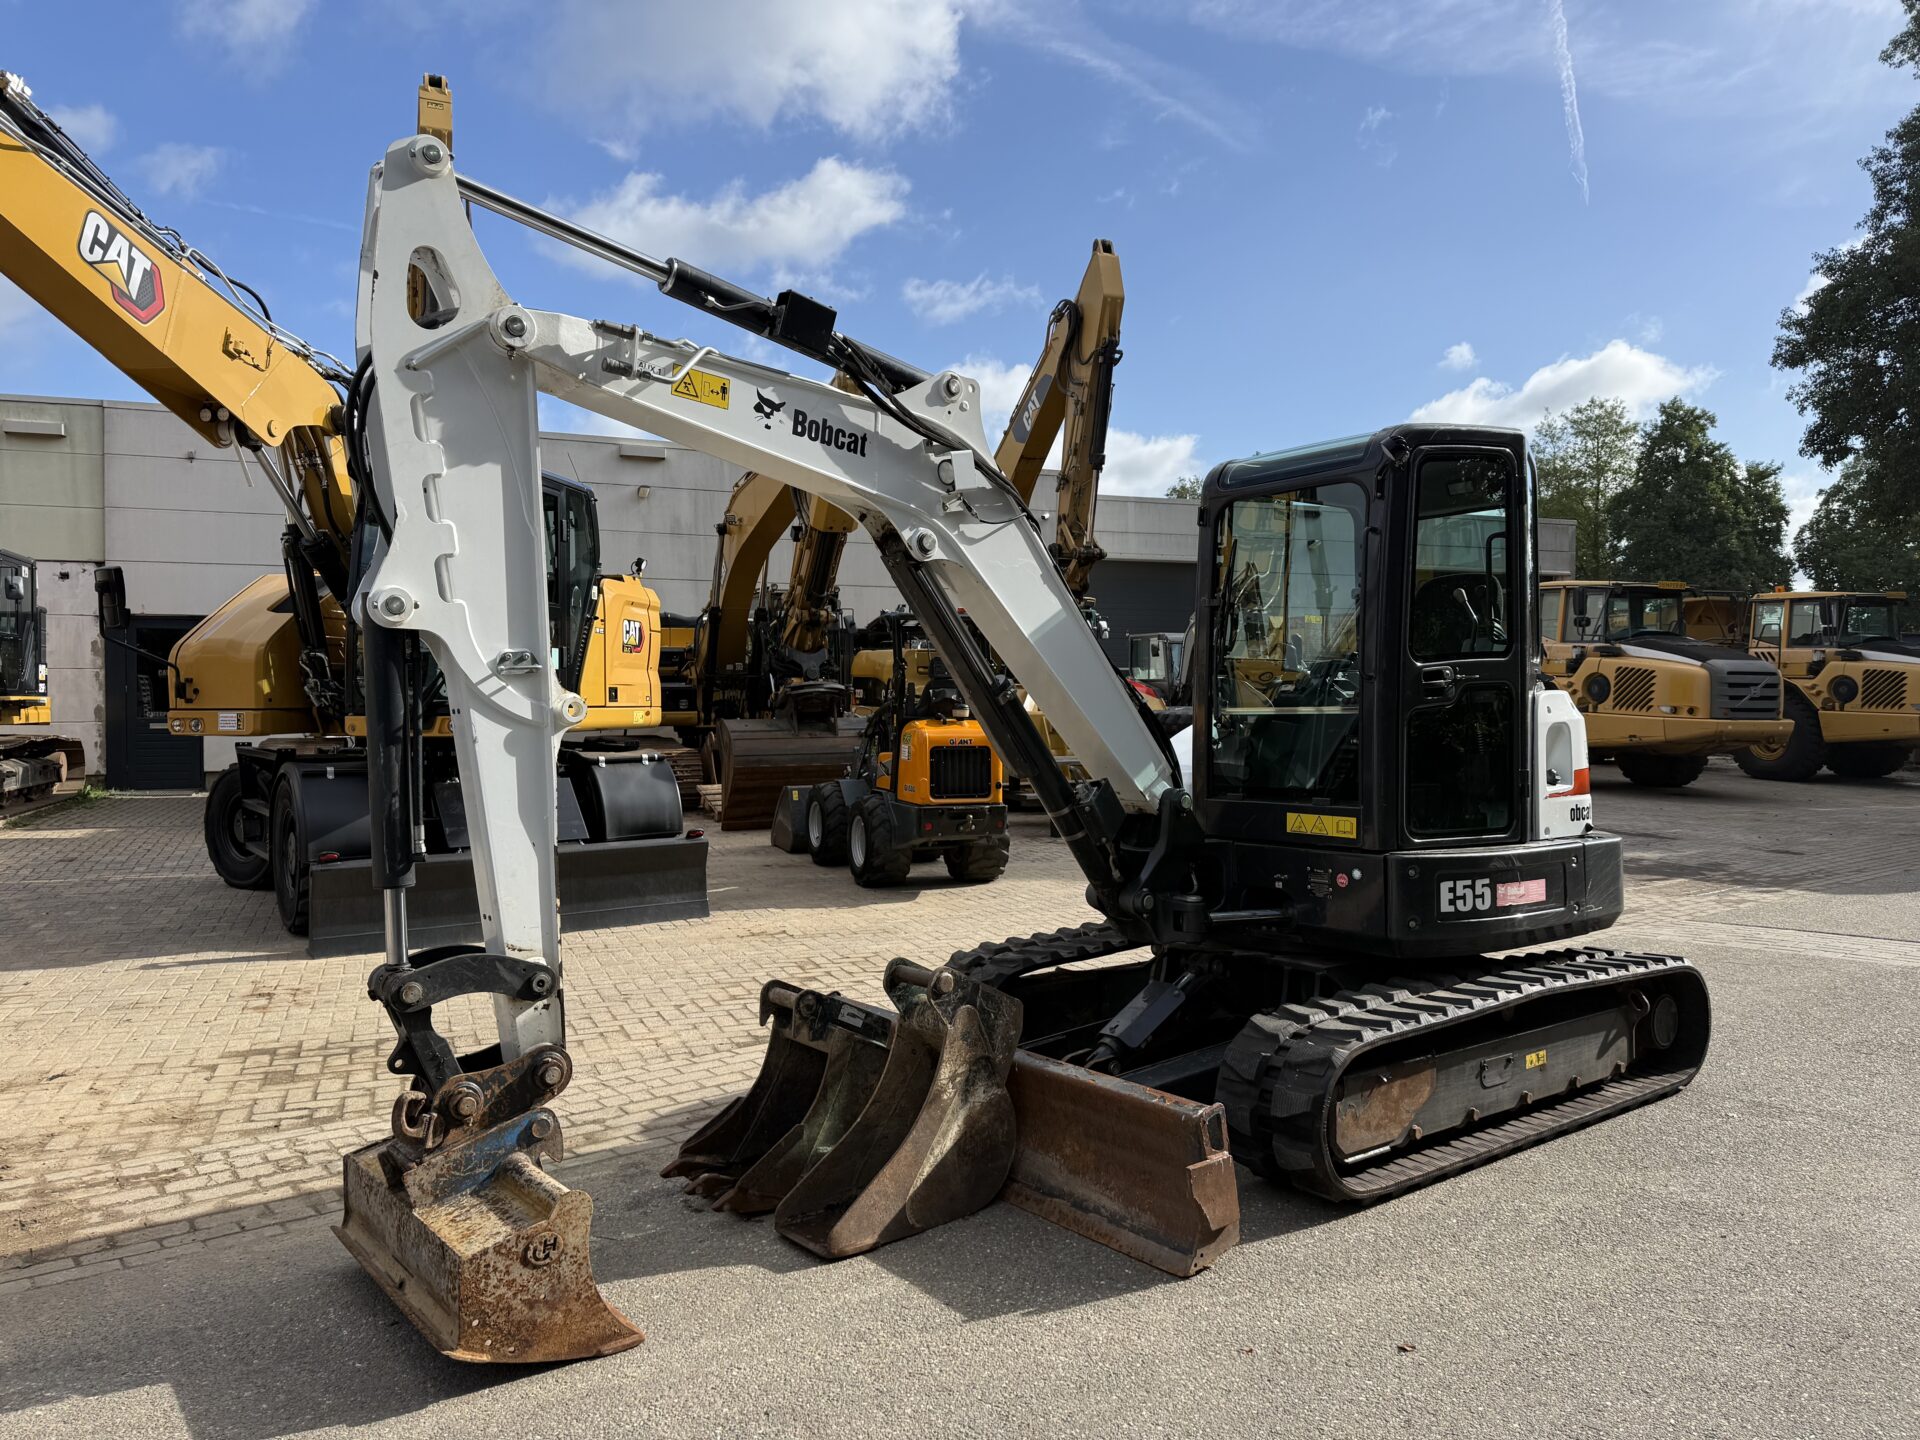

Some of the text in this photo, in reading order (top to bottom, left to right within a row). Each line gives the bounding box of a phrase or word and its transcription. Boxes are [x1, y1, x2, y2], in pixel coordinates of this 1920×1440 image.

[80, 211, 152, 300] CAT
[1022, 389, 1041, 432] CAT
[792, 408, 867, 458] Bobcat
[623, 619, 642, 647] CAT
[1570, 804, 1592, 822] obca
[1440, 878, 1492, 913] E55
